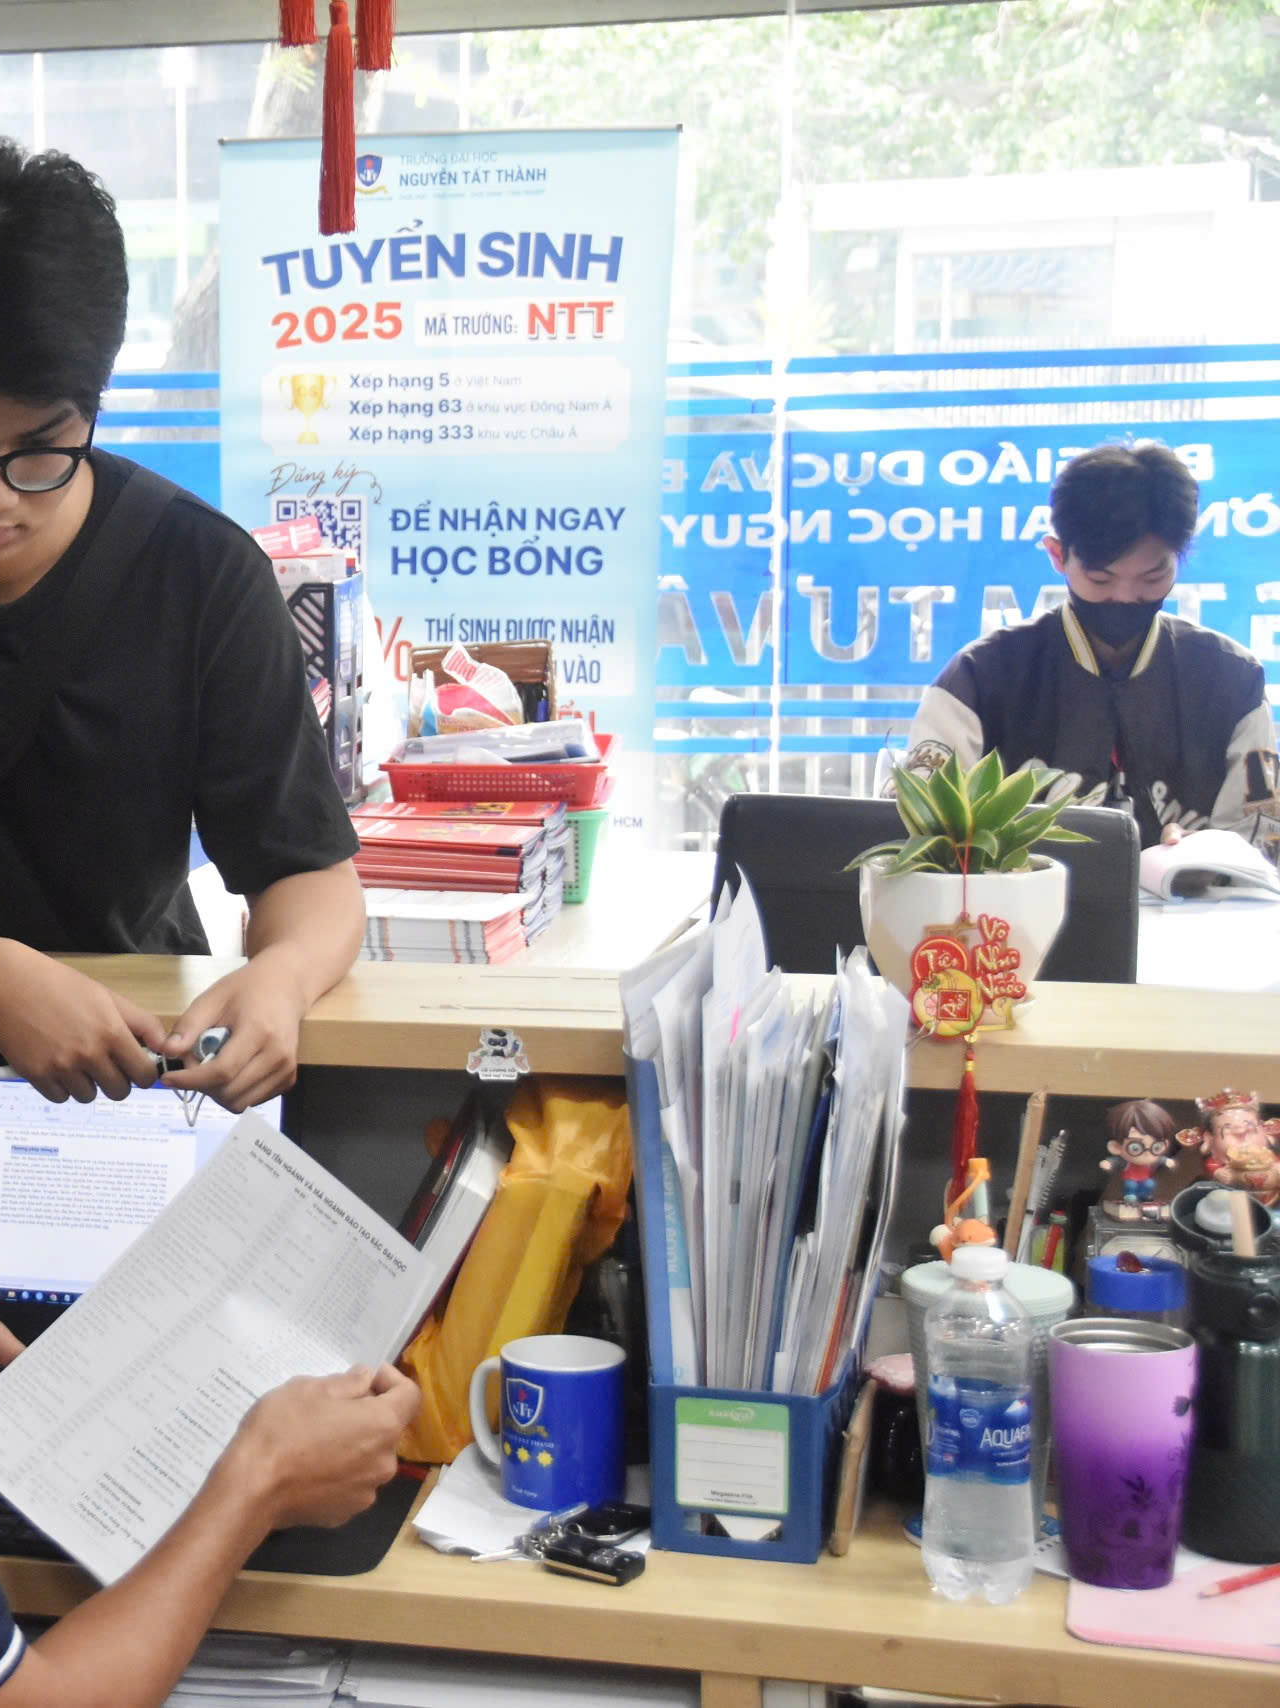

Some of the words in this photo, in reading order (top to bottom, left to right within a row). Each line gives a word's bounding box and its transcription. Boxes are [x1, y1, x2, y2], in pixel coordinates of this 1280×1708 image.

[399, 170, 457, 187] NGUYỄN
[463, 168, 491, 185] TẤT
[496, 165, 547, 183] THÀNH
[262, 218, 467, 296] TUYỂN
[476, 231, 624, 283] SINH
[270, 301, 403, 349] 2025
[424, 312, 447, 336] MÃ
[452, 309, 518, 336] TRƯỜNG:
[527, 301, 614, 339] NTT
[349, 374, 383, 391] Xếp
[388, 374, 433, 391] hạng
[439, 372, 450, 387] 5
[349, 400, 383, 417] Xếp
[388, 400, 433, 418] hạng
[438, 399, 462, 414] 63
[349, 426, 383, 443] Xếp
[388, 426, 433, 444] hạng
[438, 425, 474, 440] 333
[390, 499, 431, 532] ĐỂ
[439, 500, 527, 537] NHẬN
[535, 506, 626, 531] NGAY
[390, 545, 477, 583] HỌC
[487, 536, 604, 576] BỔNG
[425, 613, 455, 642] THÍ
[459, 618, 500, 642] SINH
[561, 614, 615, 648] NHẬN
[563, 656, 601, 684] VÀO
[614, 816, 643, 829] HCM
